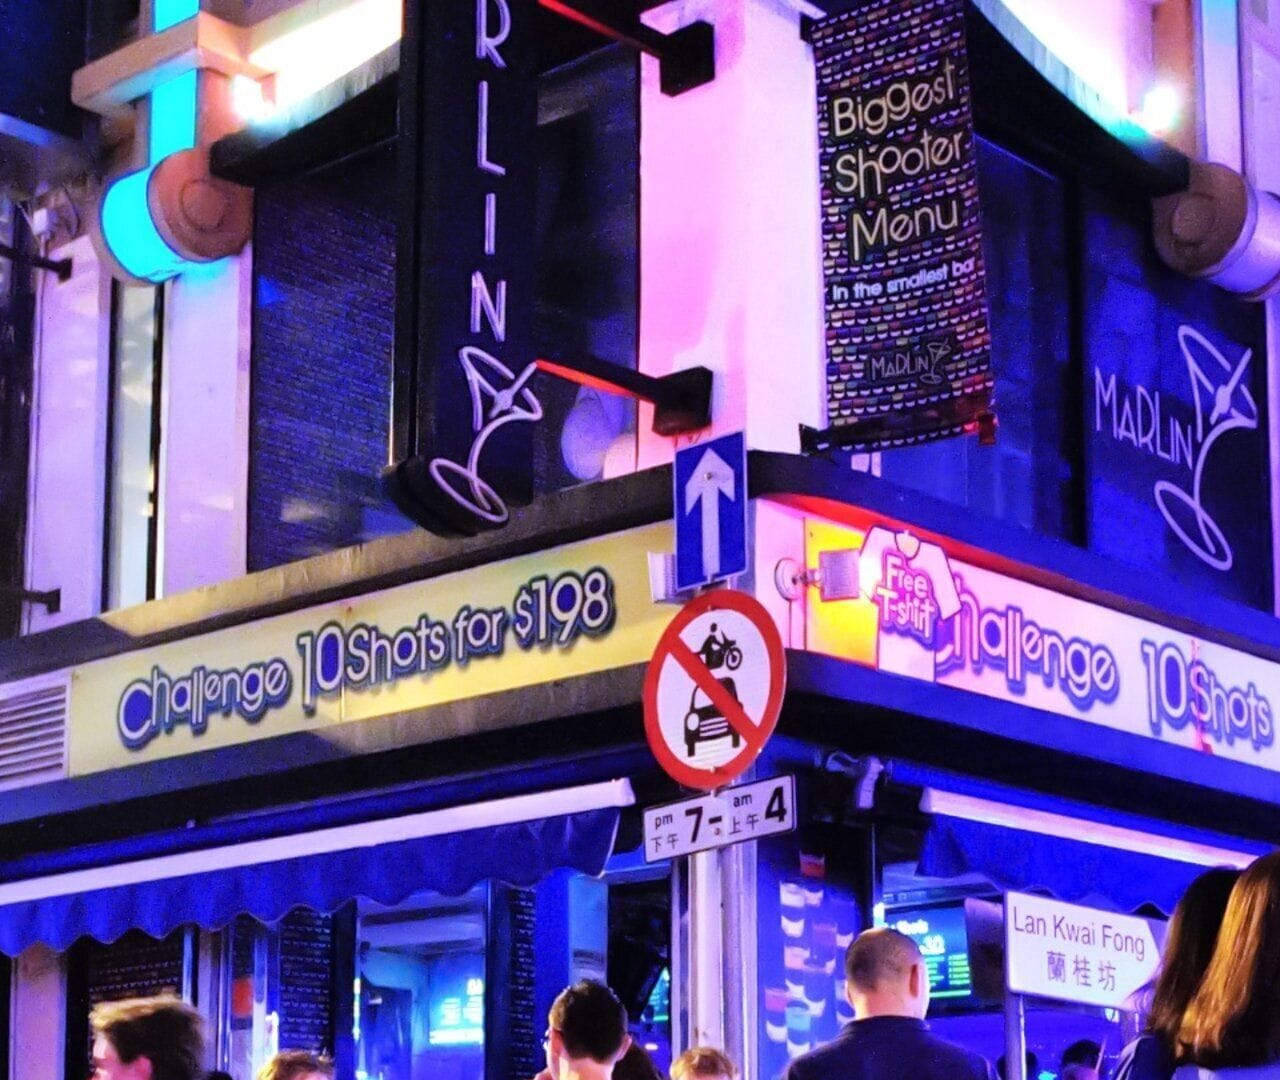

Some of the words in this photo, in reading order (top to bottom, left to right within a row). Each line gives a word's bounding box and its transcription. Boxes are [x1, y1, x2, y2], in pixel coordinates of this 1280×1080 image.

[833, 56, 956, 137] Biggest
[835, 127, 963, 199] Shooter
[852, 199, 959, 261] Menu
[853, 282, 883, 298] the
[886, 263, 949, 293] smallest
[886, 553, 929, 598] Free
[876, 585, 935, 639] T-shirt
[936, 576, 1116, 698] hallenge
[119, 658, 289, 742] Challenge
[456, 606, 505, 660] for
[514, 570, 610, 643] $198
[651, 833, 680, 853] 下午
[728, 813, 760, 836] 上午
[654, 813, 674, 830] pm
[733, 793, 753, 808] am
[764, 785, 788, 823] 4
[1013, 905, 1047, 937] Lan
[1053, 914, 1096, 946] Kwai
[1101, 924, 1145, 962] Fong
[1046, 950, 1117, 992] 蘭桂坊
